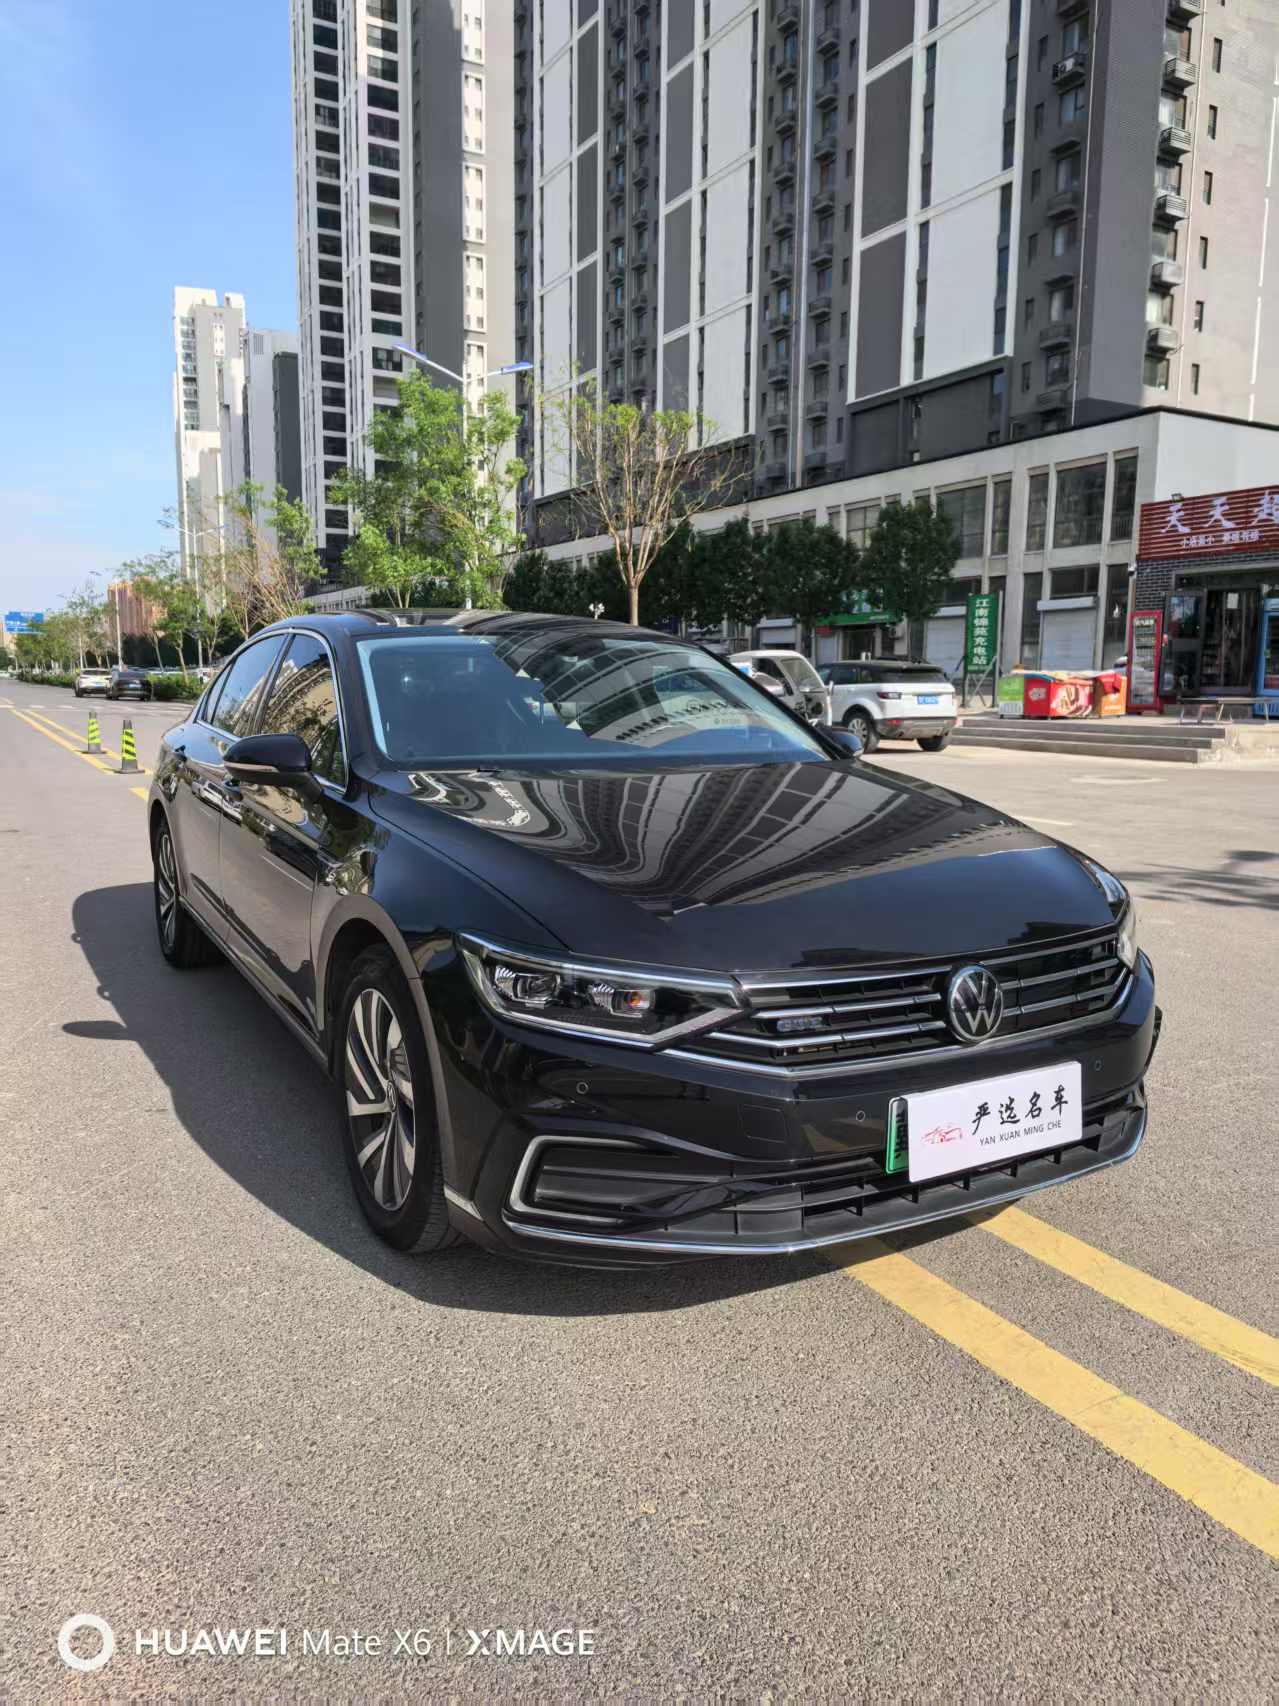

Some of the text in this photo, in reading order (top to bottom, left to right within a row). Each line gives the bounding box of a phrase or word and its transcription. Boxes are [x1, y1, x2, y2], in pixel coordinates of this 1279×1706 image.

[972, 598, 991, 664] 江南锦苑充电站
[972, 1085, 1068, 1135] 严选名车
[980, 1120, 1062, 1146] YAN XUAN MING CHE
